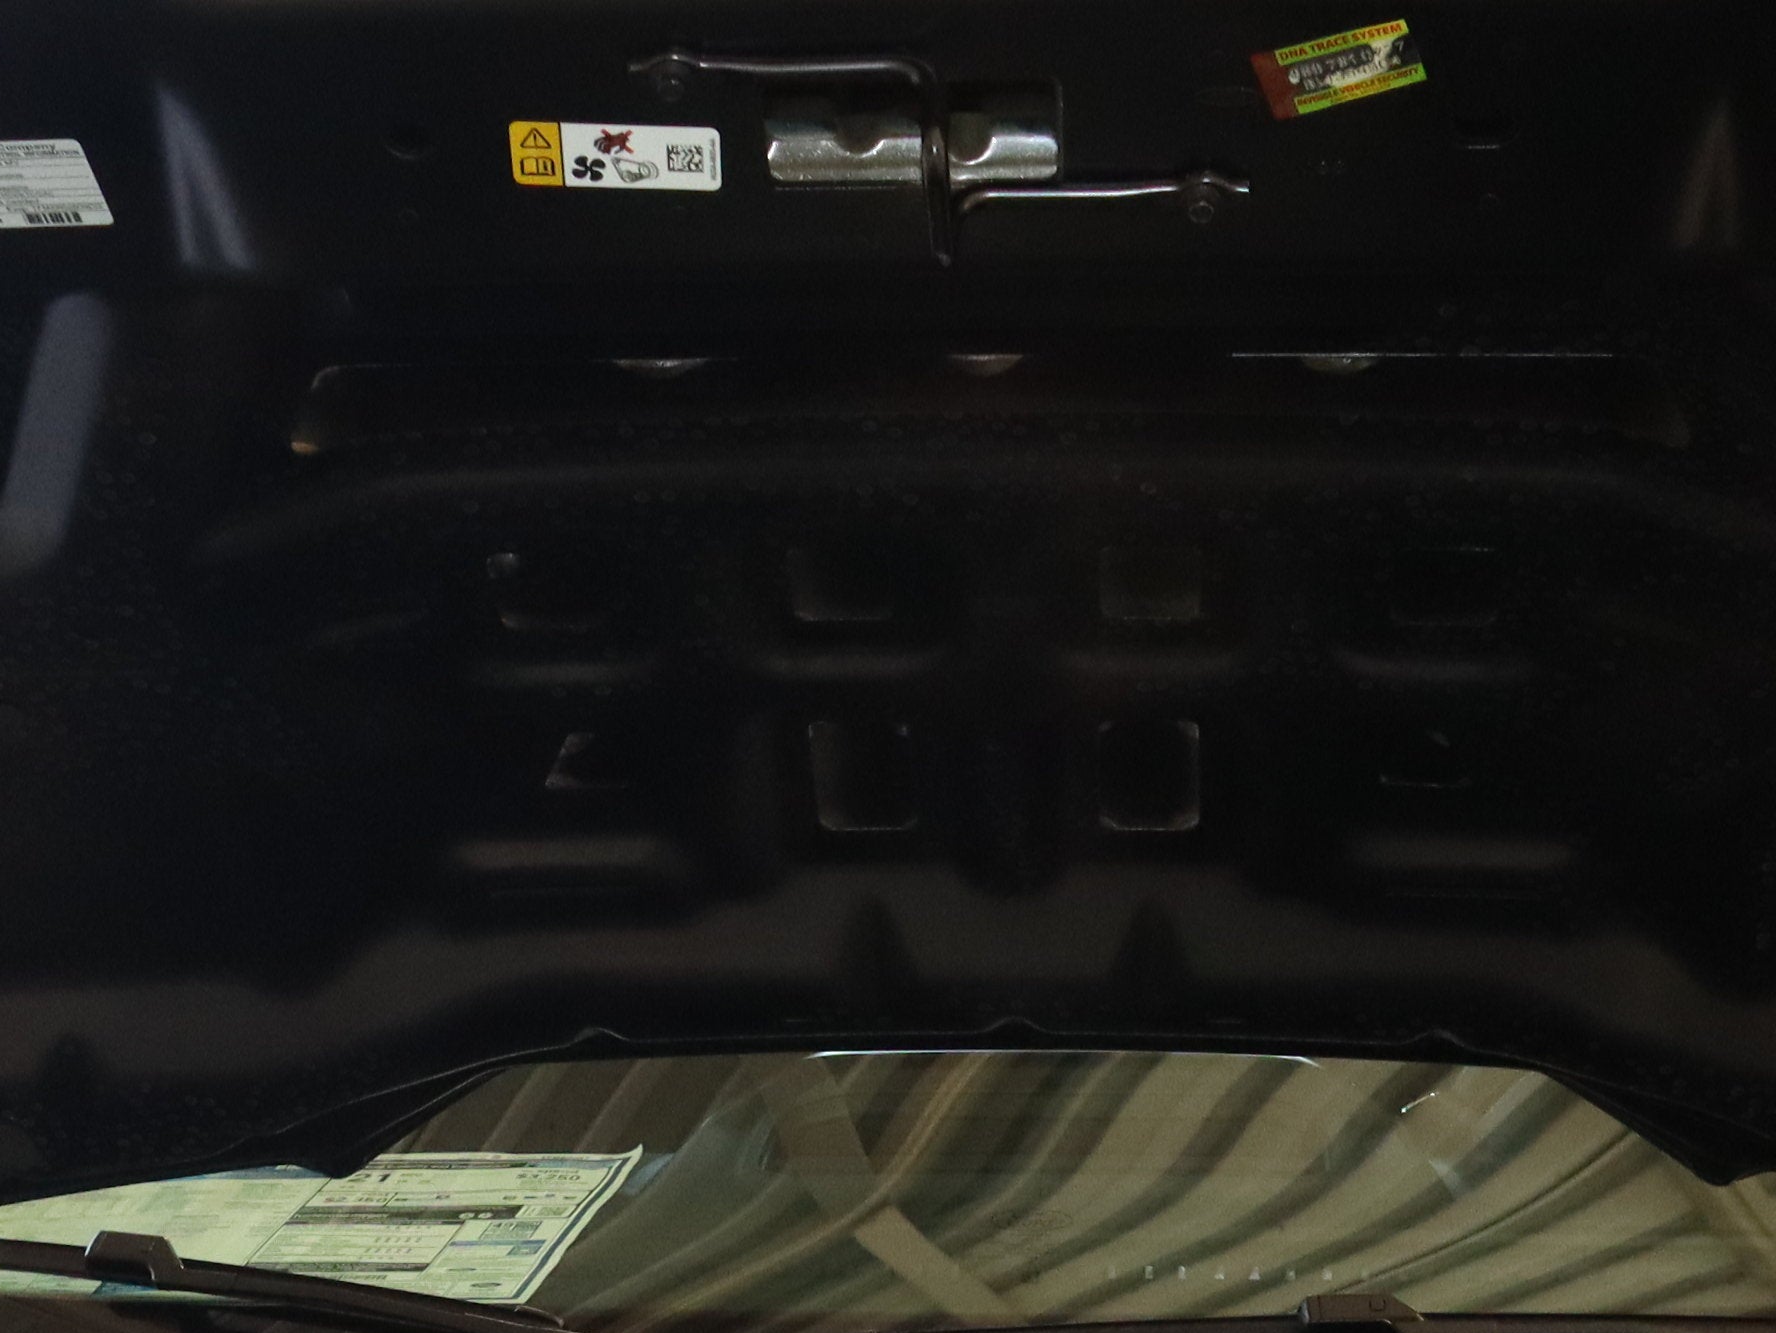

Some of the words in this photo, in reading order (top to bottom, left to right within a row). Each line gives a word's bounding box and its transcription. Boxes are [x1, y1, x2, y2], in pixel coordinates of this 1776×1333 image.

[1279, 45, 1308, 61] DNA
[1309, 35, 1349, 53] TRACE
[1351, 22, 1403, 42] SYSTEM
